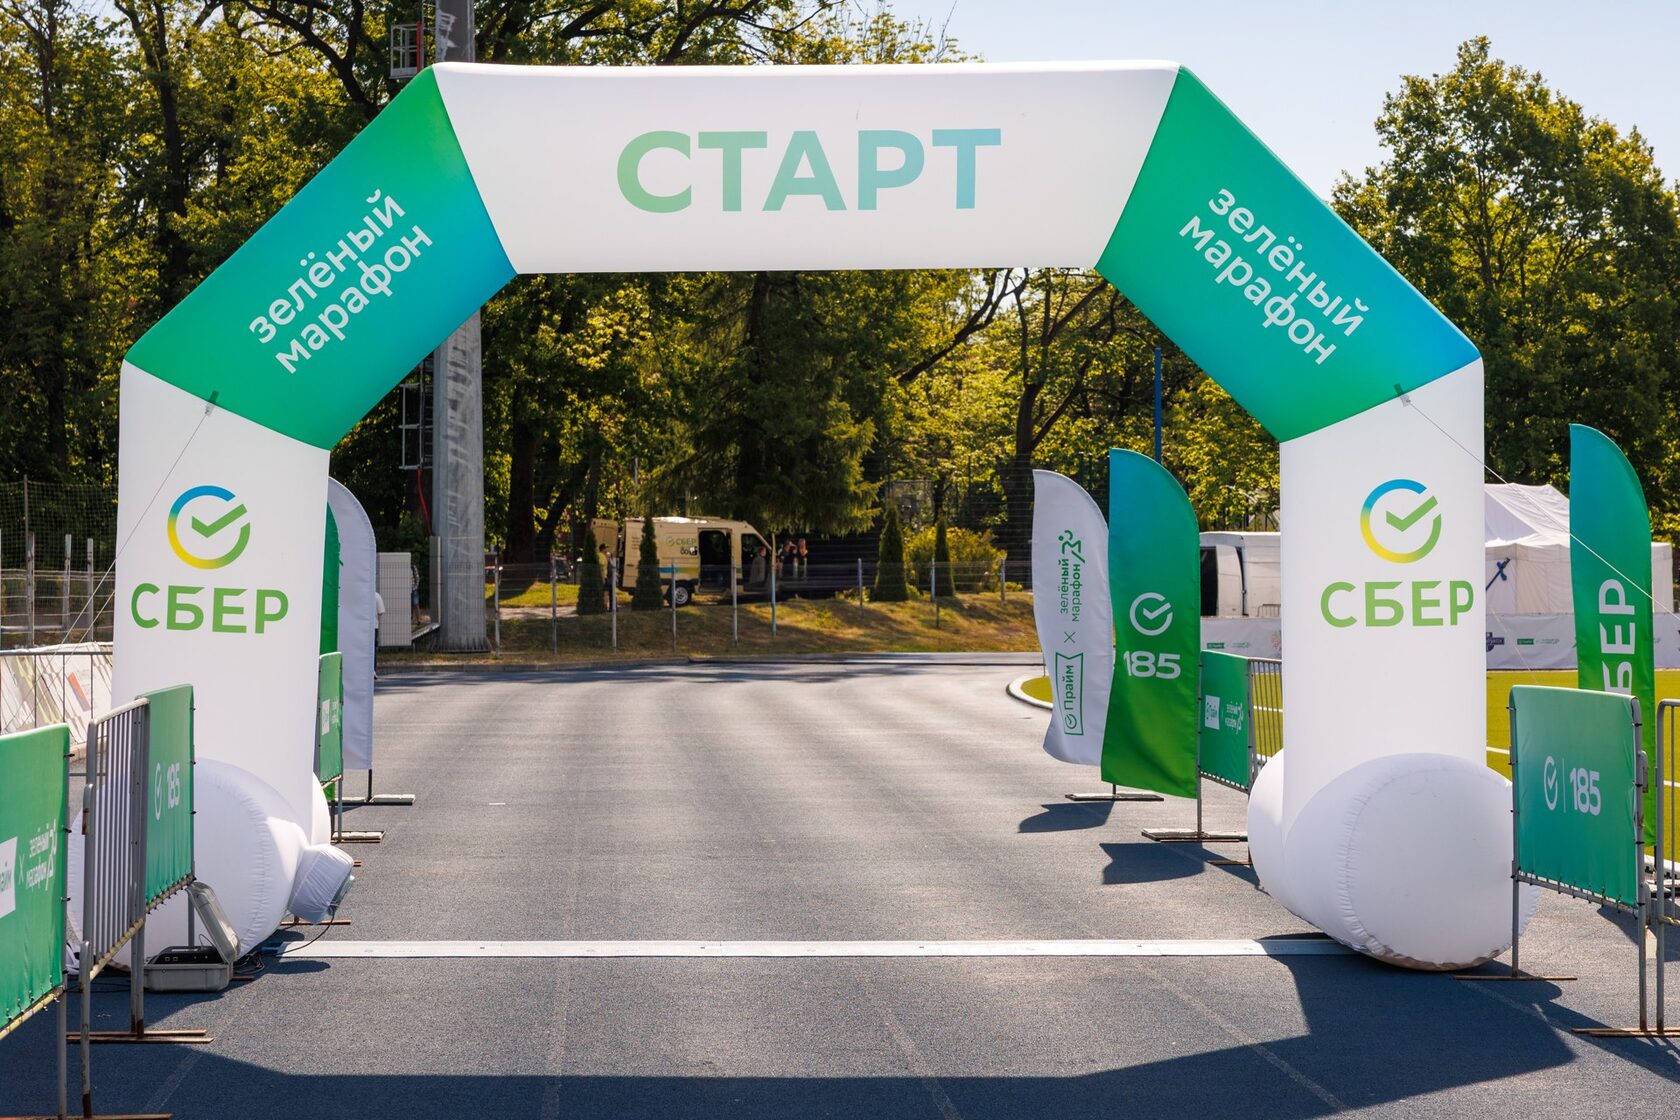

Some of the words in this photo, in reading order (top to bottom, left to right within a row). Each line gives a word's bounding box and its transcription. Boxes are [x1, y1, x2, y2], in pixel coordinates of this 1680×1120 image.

[617, 128, 1001, 213] СТАРТ
[248, 189, 405, 344] зелёный
[1178, 215, 1337, 365] марафон
[1207, 188, 1369, 338] зелёный
[275, 225, 433, 374] марафон
[130, 582, 289, 634] СБЕР
[1057, 558, 1070, 615] зелёный
[1070, 563, 1083, 622] марафон
[1320, 580, 1475, 628] СБЕР
[1123, 651, 1181, 680] 185
[1598, 578, 1636, 695] БЕР
[1062, 664, 1077, 711] Прайм
[167, 762, 180, 809] 185
[1569, 767, 1601, 816] 185
